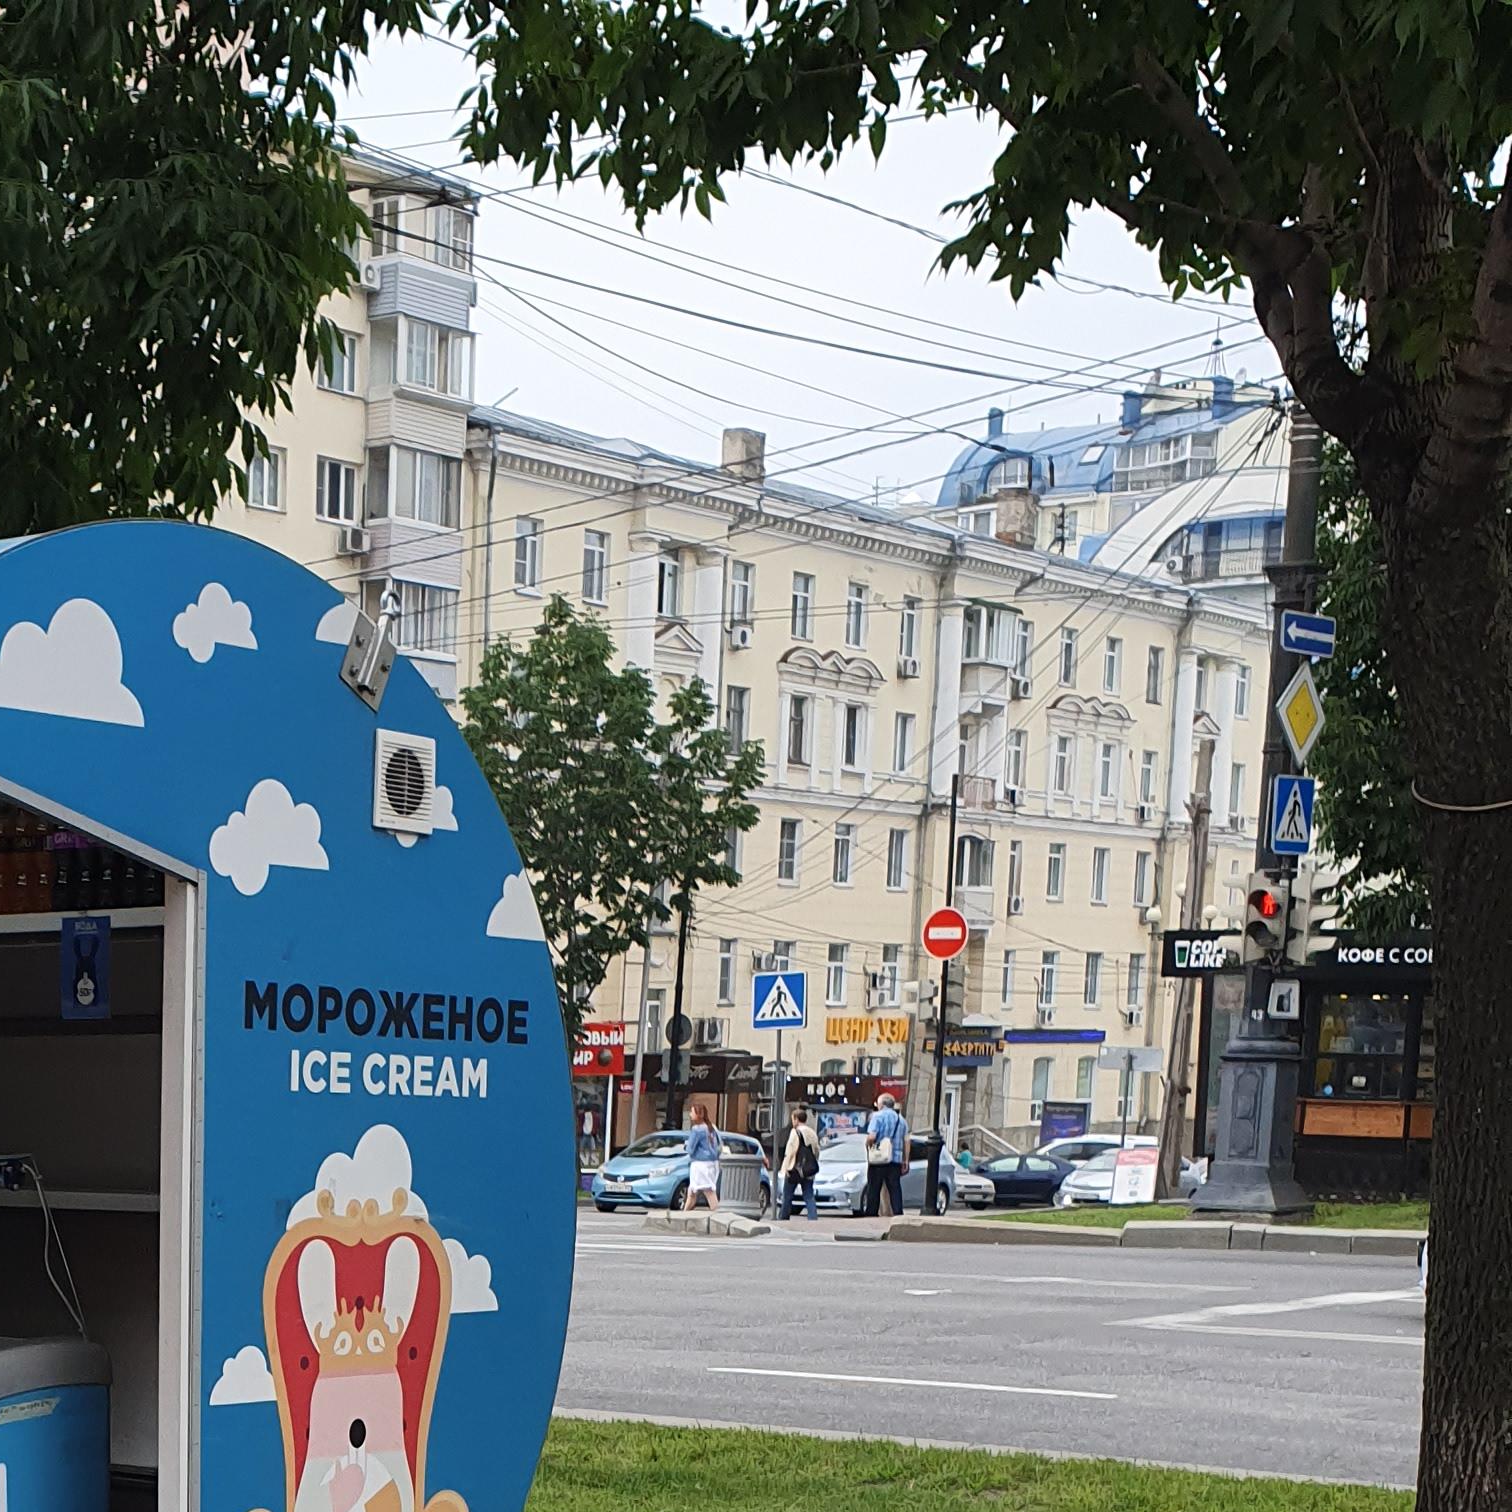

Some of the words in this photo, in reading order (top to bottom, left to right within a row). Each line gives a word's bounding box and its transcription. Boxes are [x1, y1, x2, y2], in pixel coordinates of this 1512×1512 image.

[1191, 939, 1223, 954] COF
[1189, 954, 1226, 968] LIKE
[1337, 947, 1385, 963] КОФЕ
[1389, 947, 1400, 963] С
[1404, 947, 1433, 963] СО
[243, 980, 530, 1045] МОРОЖЕНОЕ
[575, 1027, 624, 1046] ОВЫЙ
[876, 1016, 909, 1043] УЗИ
[943, 1040, 995, 1056] ЕФЕРТИТИ
[573, 1050, 594, 1065] ИР
[290, 1049, 351, 1094] ICE
[362, 1052, 488, 1099] CREAM
